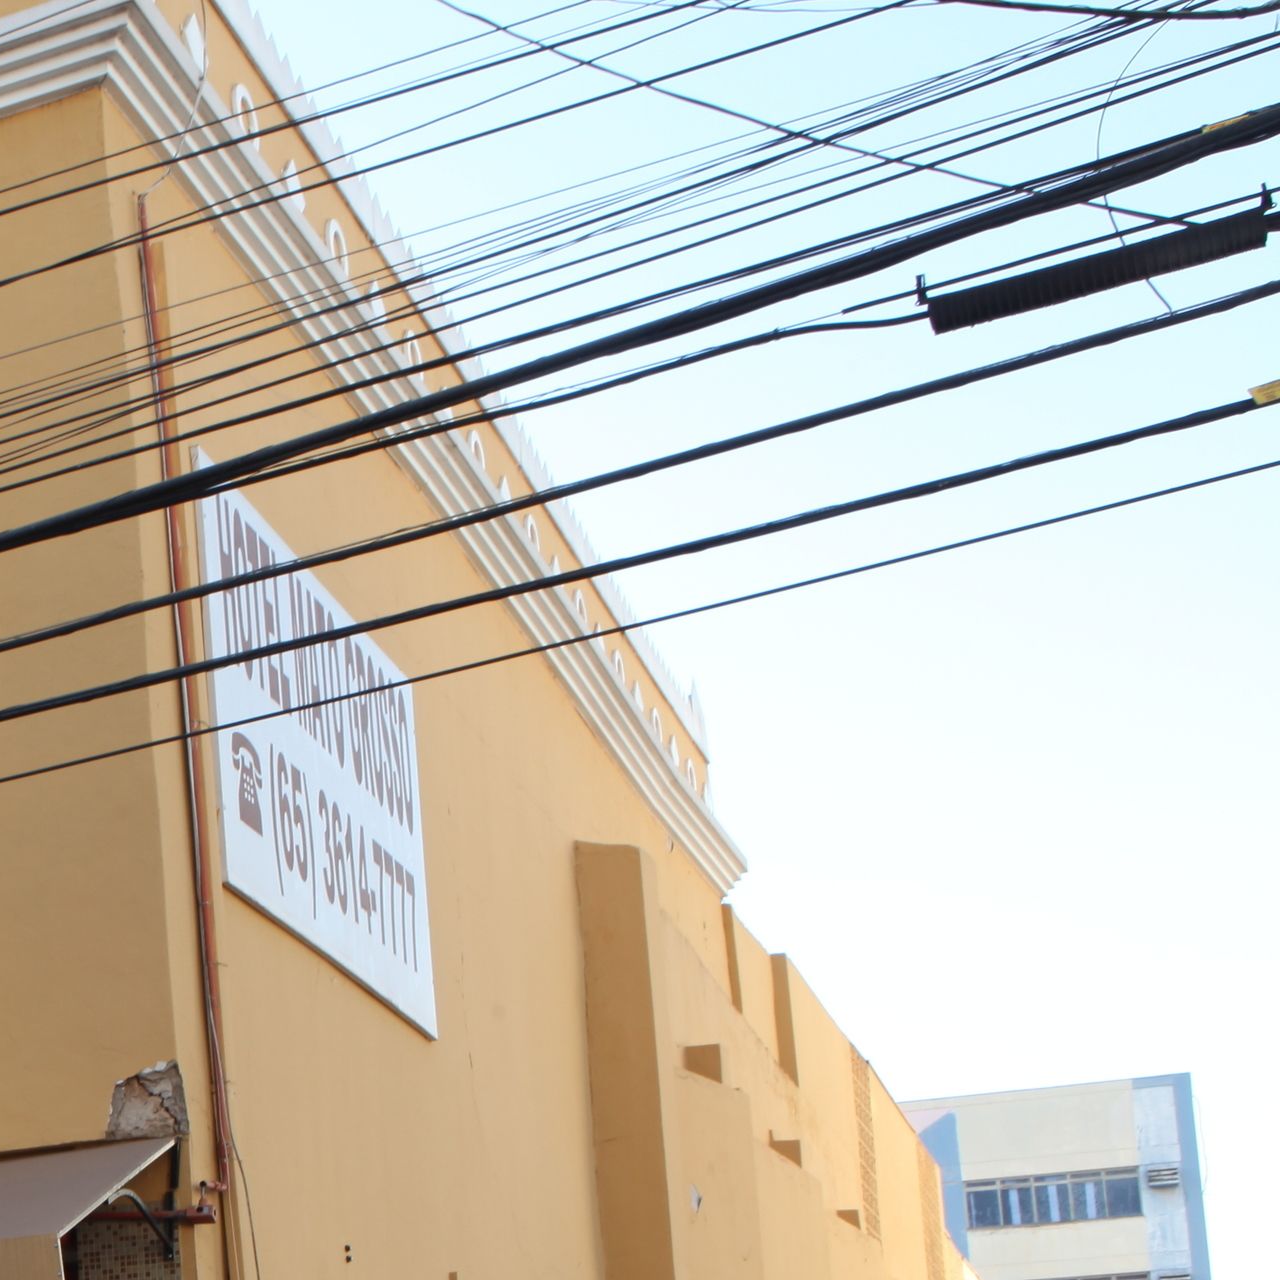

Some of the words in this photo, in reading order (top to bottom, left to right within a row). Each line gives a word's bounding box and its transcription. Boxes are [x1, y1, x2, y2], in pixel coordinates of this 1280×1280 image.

[216, 491, 292, 717] HOTEL
[291, 569, 345, 769] MATO
[344, 633, 414, 836] GROSSO
[270, 743, 316, 920] (65)
[318, 789, 417, 973] 3614-7777
